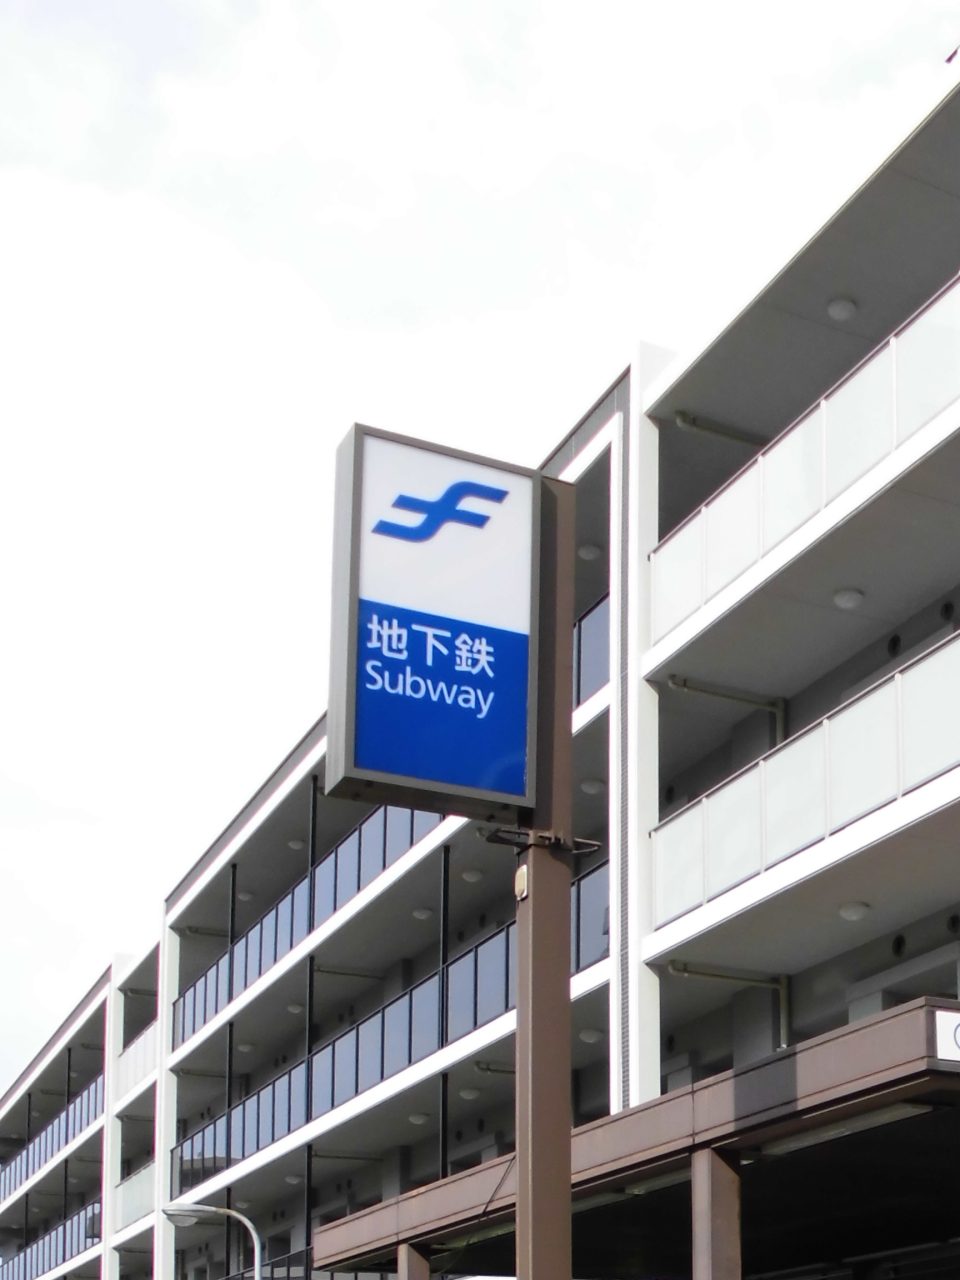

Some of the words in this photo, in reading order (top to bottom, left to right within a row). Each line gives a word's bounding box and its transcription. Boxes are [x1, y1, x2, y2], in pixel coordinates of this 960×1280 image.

[366, 614, 495, 678] 地下鉄
[365, 660, 495, 719] Subway
